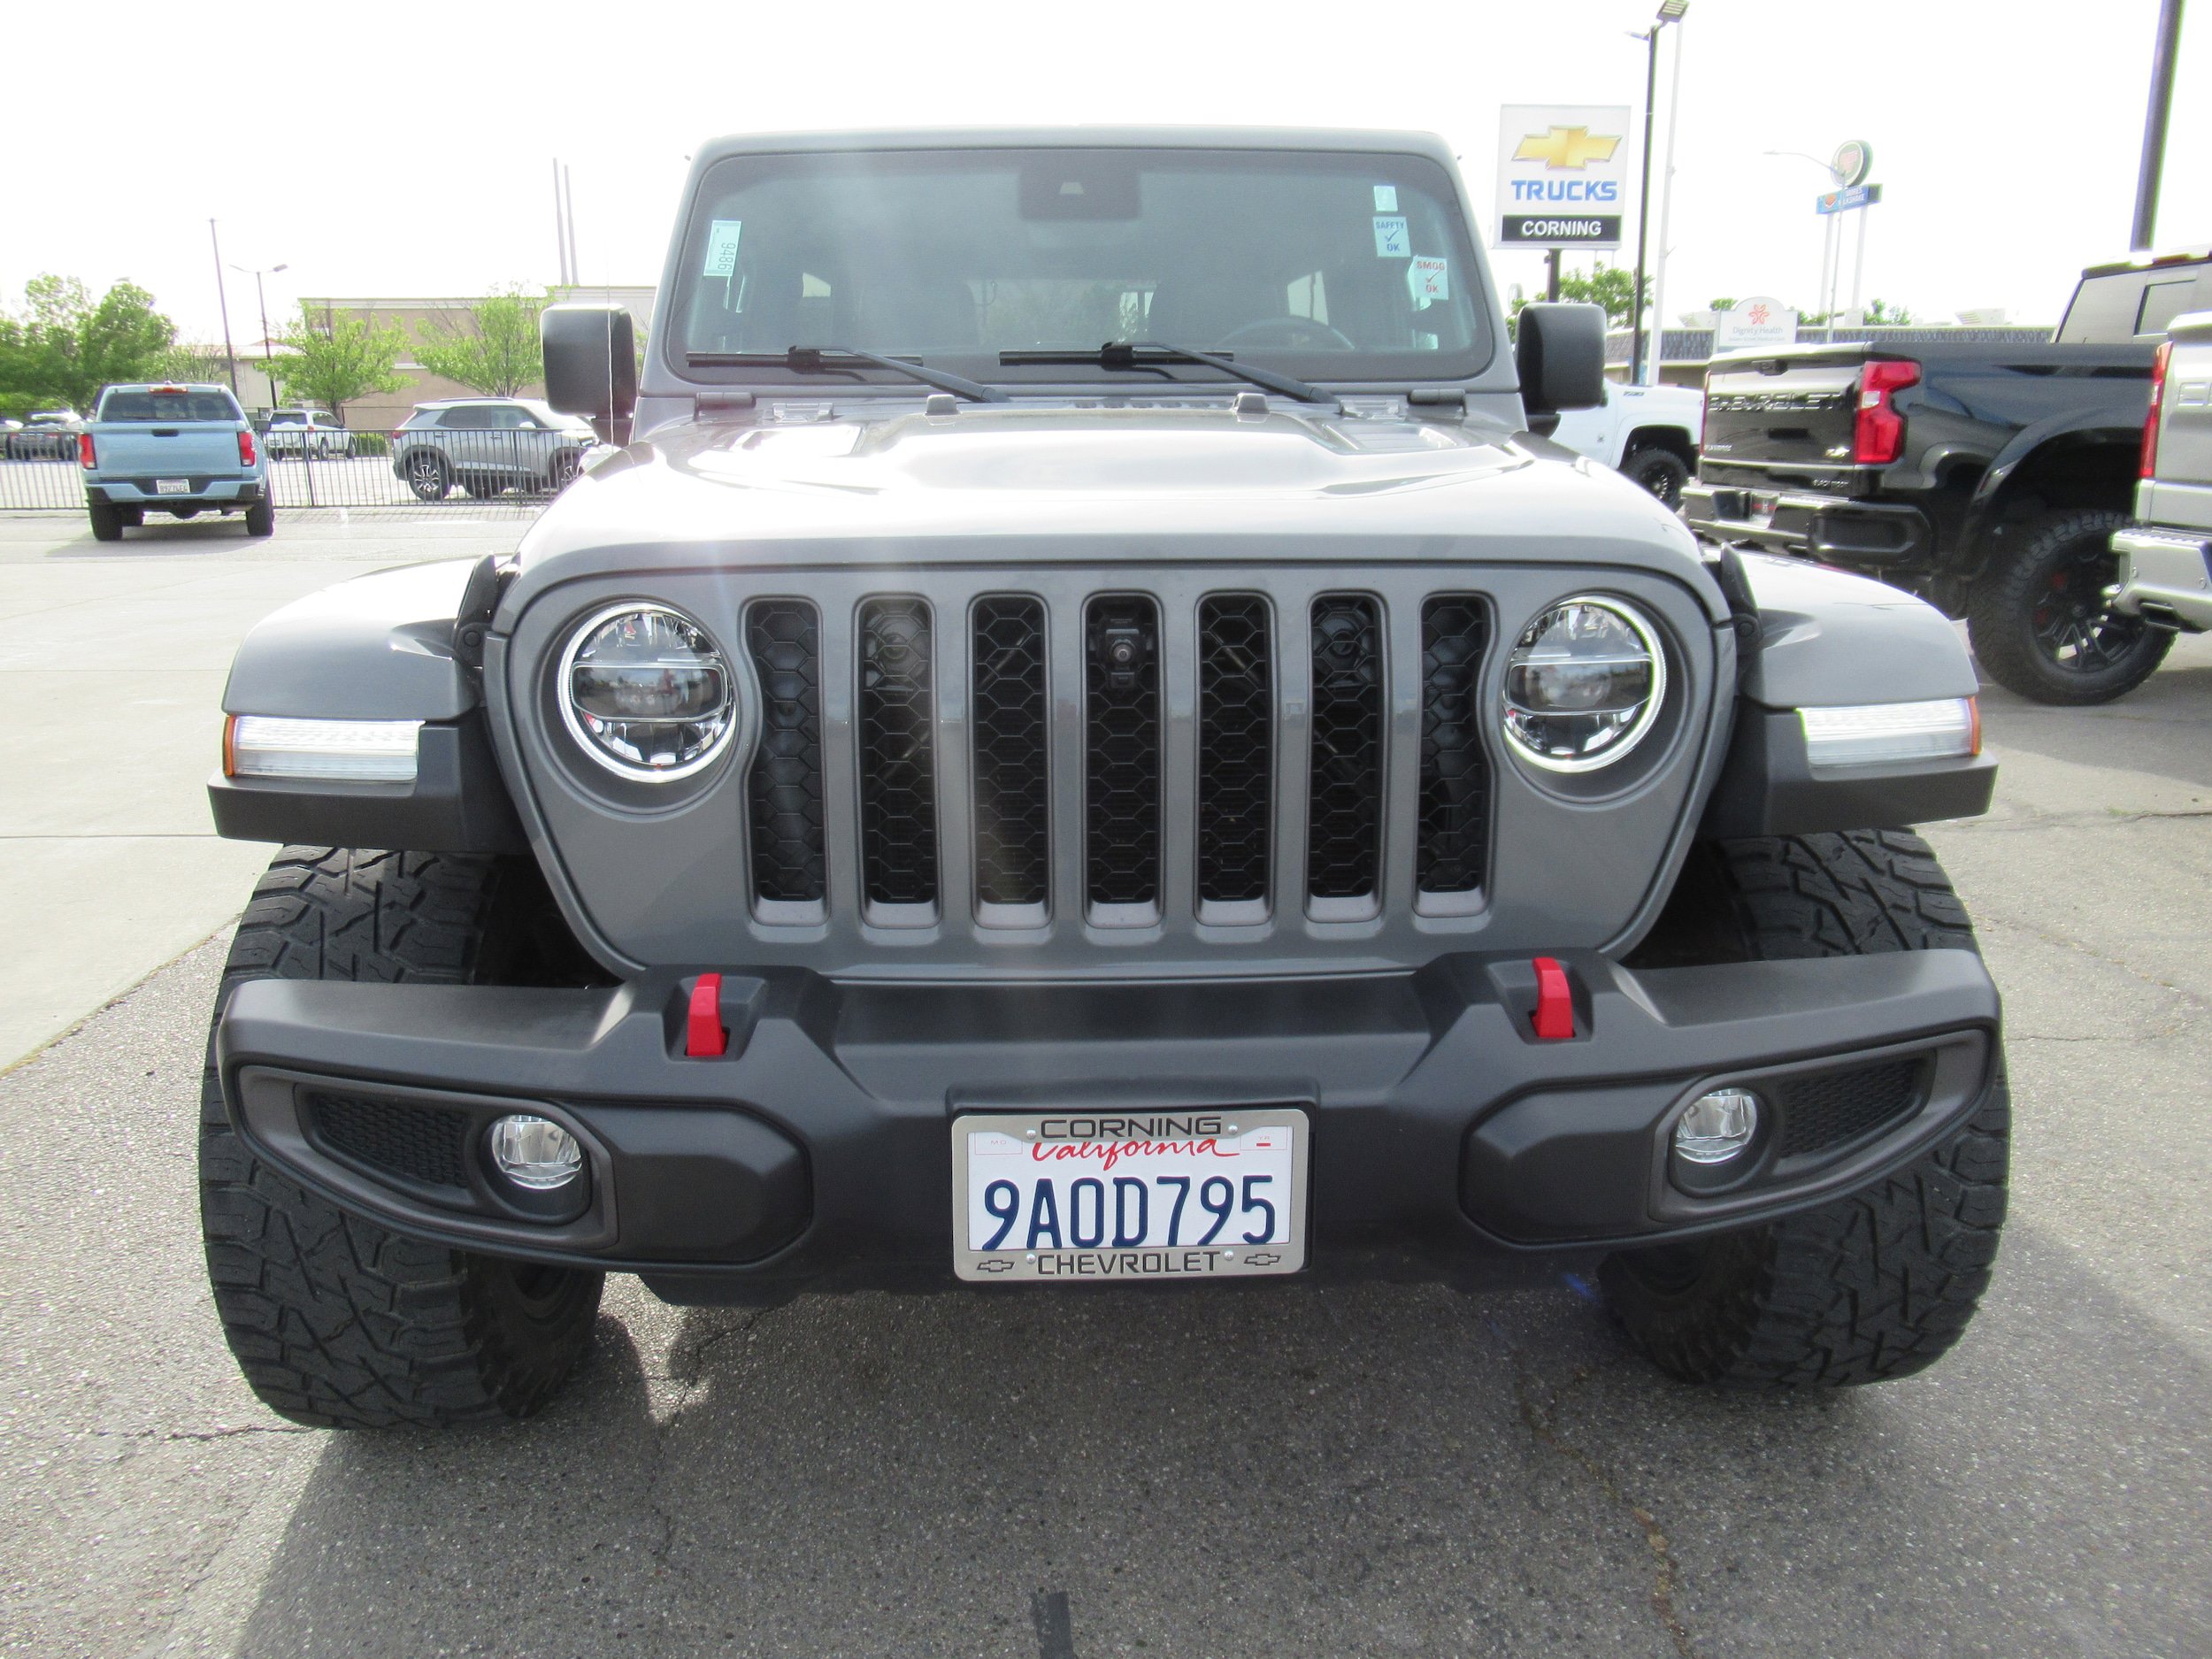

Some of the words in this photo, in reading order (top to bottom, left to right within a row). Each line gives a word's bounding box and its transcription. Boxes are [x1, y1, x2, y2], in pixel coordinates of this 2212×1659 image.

[1511, 180, 1617, 201] TRUCKS
[1521, 219, 1602, 237] CORNING
[1416, 261, 1445, 270] SMOG
[1425, 284, 1439, 293] OK
[1732, 326, 1757, 335] Dignity
[1041, 1116, 1222, 1139] CORNING
[1037, 1250, 1221, 1275] CHEVROLET
